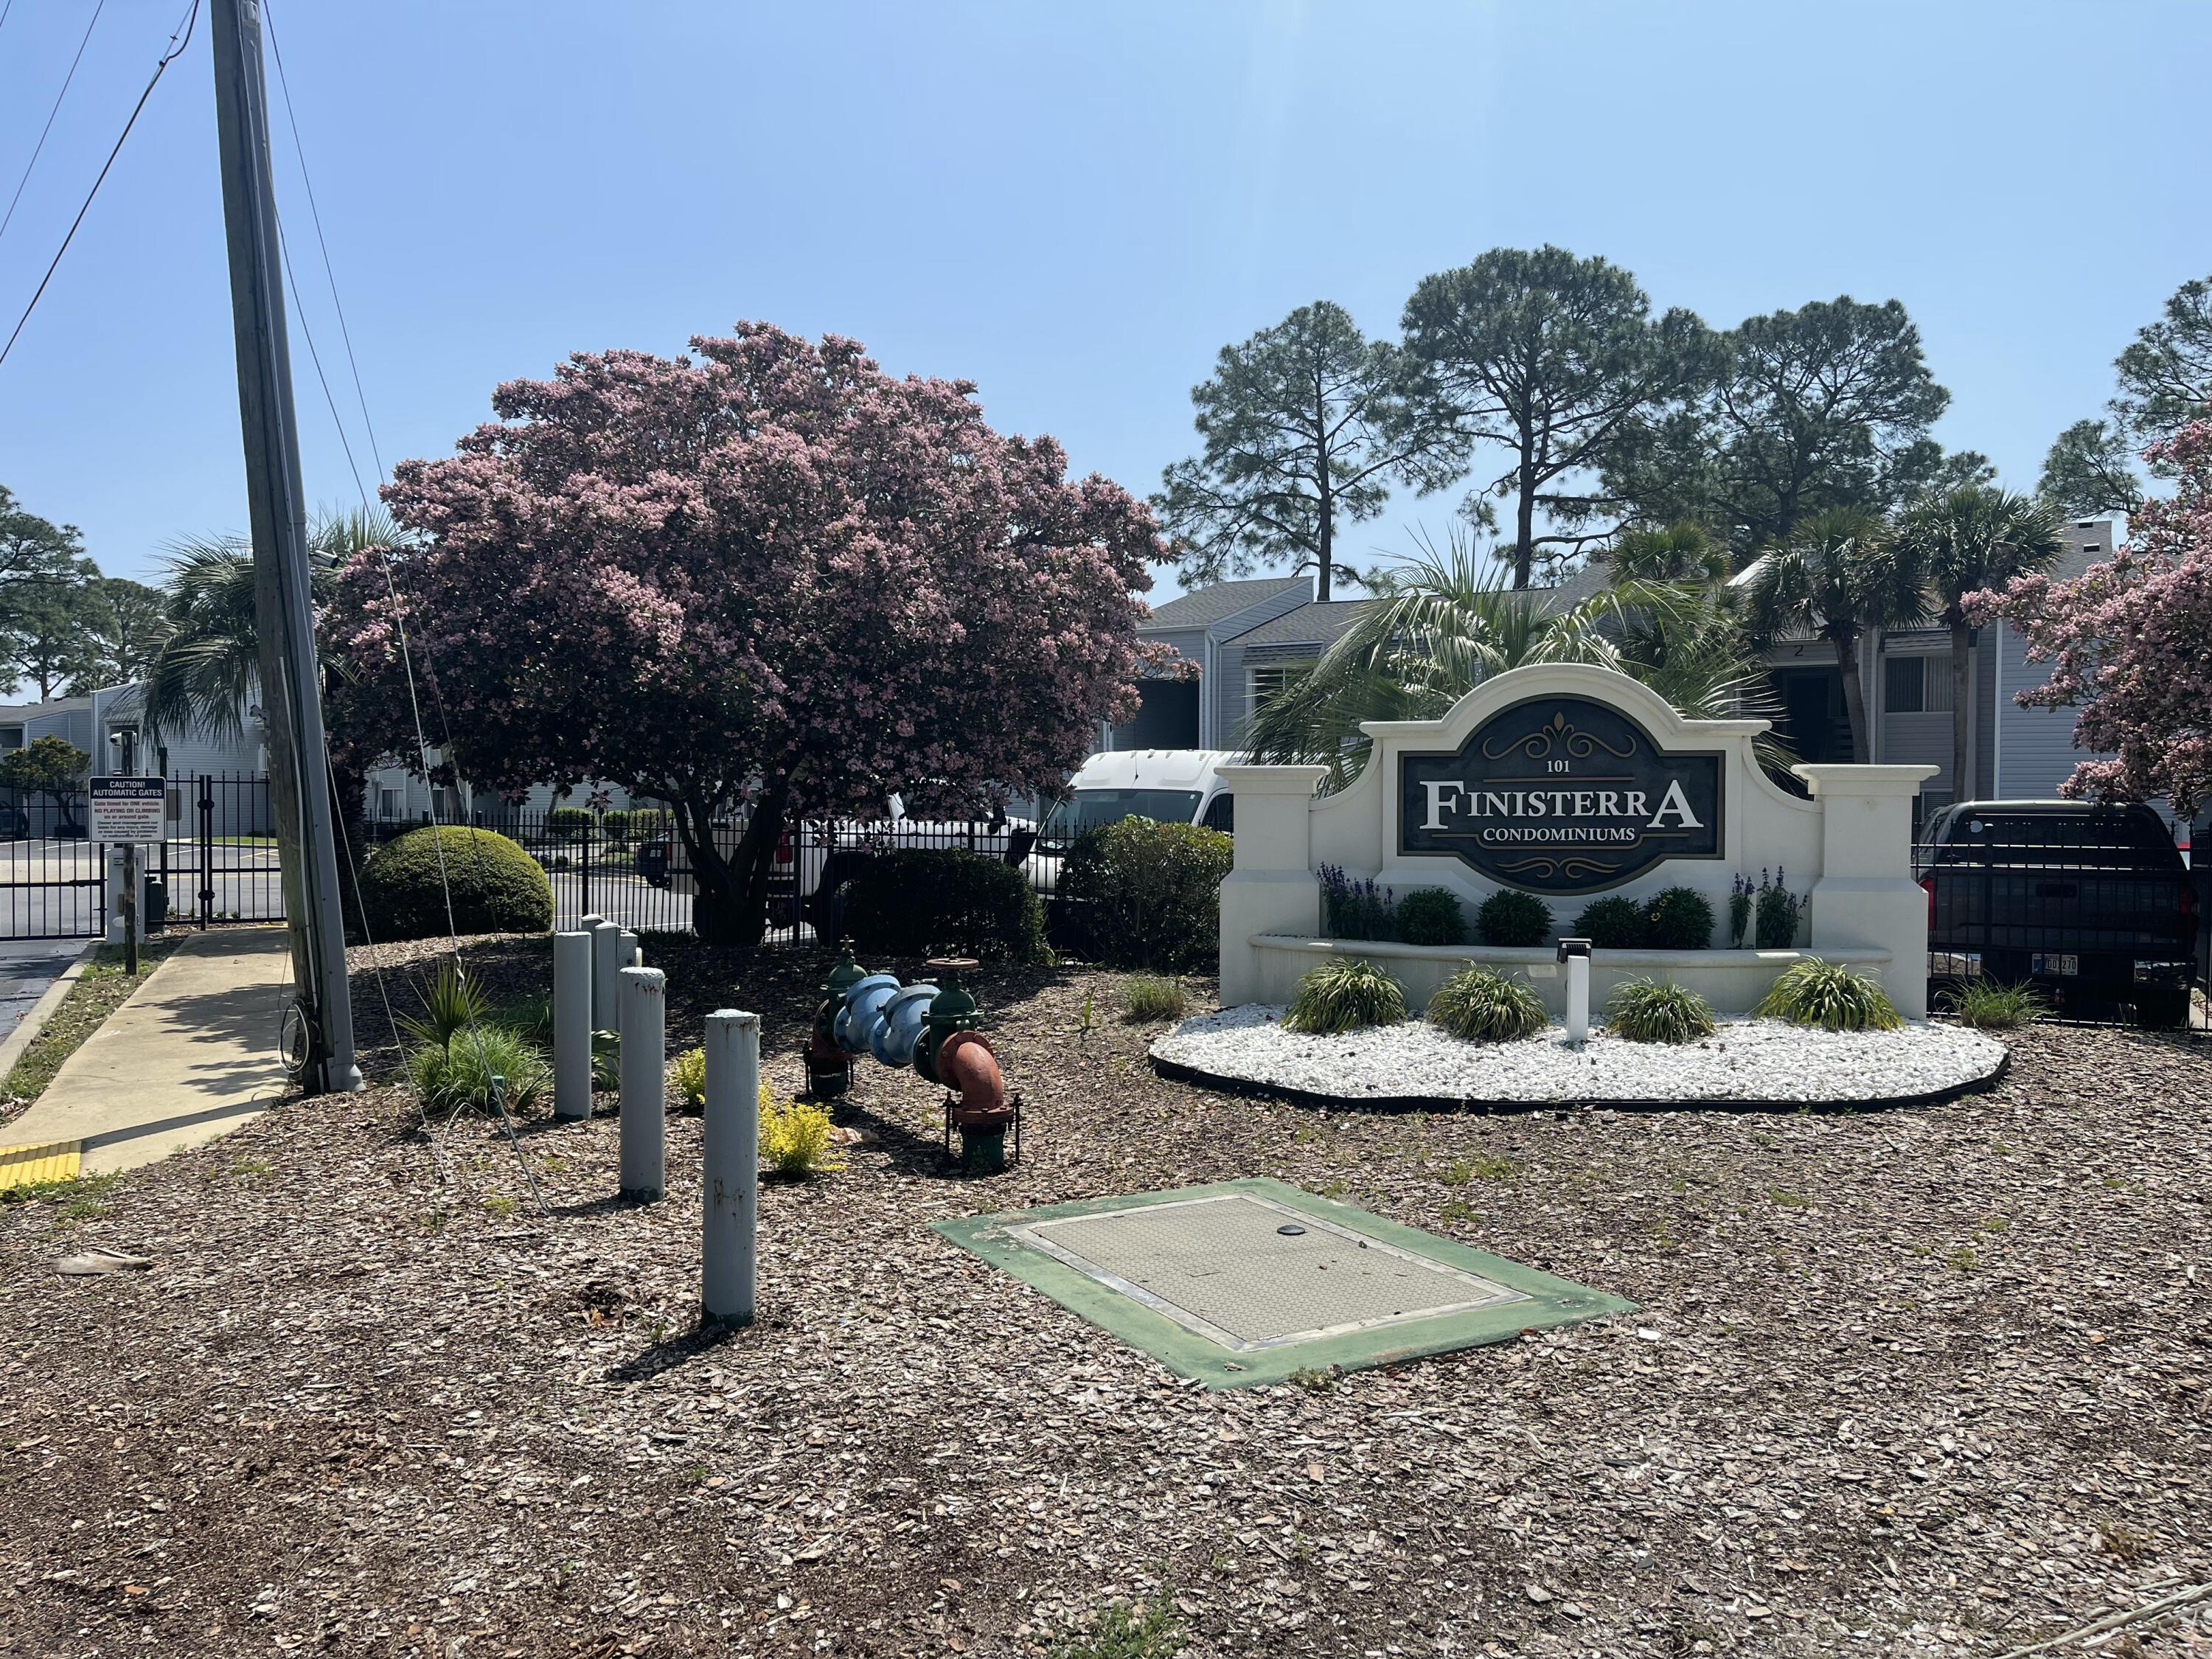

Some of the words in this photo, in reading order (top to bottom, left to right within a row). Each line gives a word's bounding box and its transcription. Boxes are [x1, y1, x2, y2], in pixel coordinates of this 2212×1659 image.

[1794, 644, 1804, 656] 2
[1546, 759, 1571, 773] 101
[1419, 779, 1704, 830] FINISTERRA
[1483, 827, 1636, 841] CONDOMINIUMS
